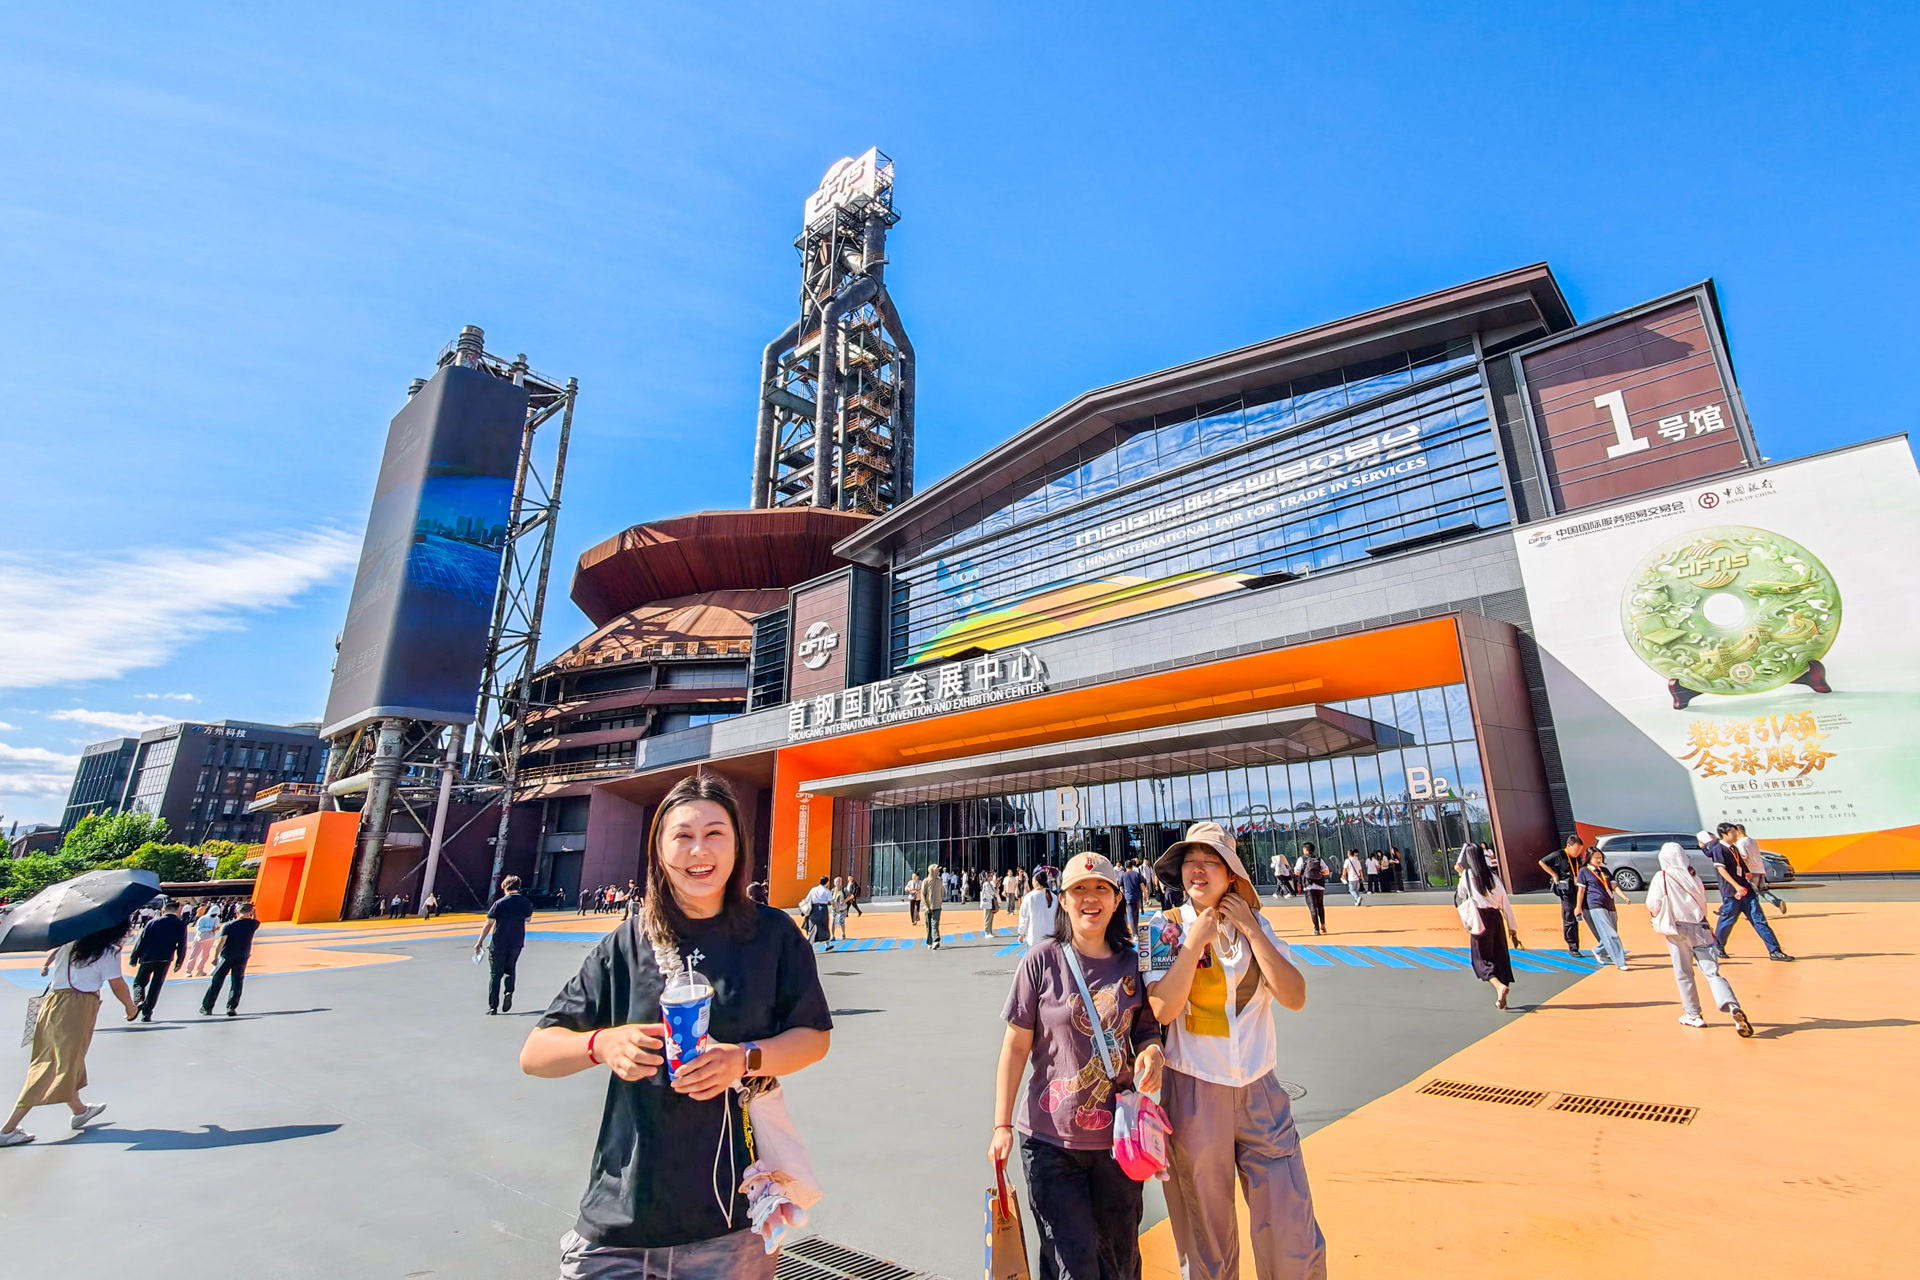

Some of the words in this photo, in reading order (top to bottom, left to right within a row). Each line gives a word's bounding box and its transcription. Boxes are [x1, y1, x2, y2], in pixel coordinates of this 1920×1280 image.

[1594, 389, 1727, 459] 1号馆
[1078, 552, 1115, 569] CHINA
[1117, 522, 1211, 558] INTERNATIONAL
[1216, 514, 1243, 528] FAIR
[1247, 503, 1276, 519] FOR
[1279, 487, 1327, 509] TRADE
[1331, 480, 1348, 493] IN
[1351, 456, 1427, 488] SERVICES
[1556, 501, 1684, 537] 中国国际服务贸易交易会
[1528, 534, 1551, 545] CIFTIS
[1676, 551, 1748, 579] CIFTIS
[798, 631, 839, 657] CIFTIS
[788, 647, 1042, 732] 首钢国际会展中心
[788, 728, 824, 742] SHOUGANG
[824, 717, 879, 735] INTERNATIONAL
[881, 704, 933, 724] CONVENTION
[934, 700, 952, 713] AND
[953, 690, 1004, 709] EXHIBITION
[1005, 682, 1044, 699] CENTER
[203, 726, 248, 738] 方州科技
[1677, 709, 1831, 760] 数智引领
[1692, 741, 1838, 778] 全球服务
[1406, 766, 1450, 800] B2
[1056, 786, 1087, 828] B1
[1139, 925, 1150, 970] RAVIJOUR
